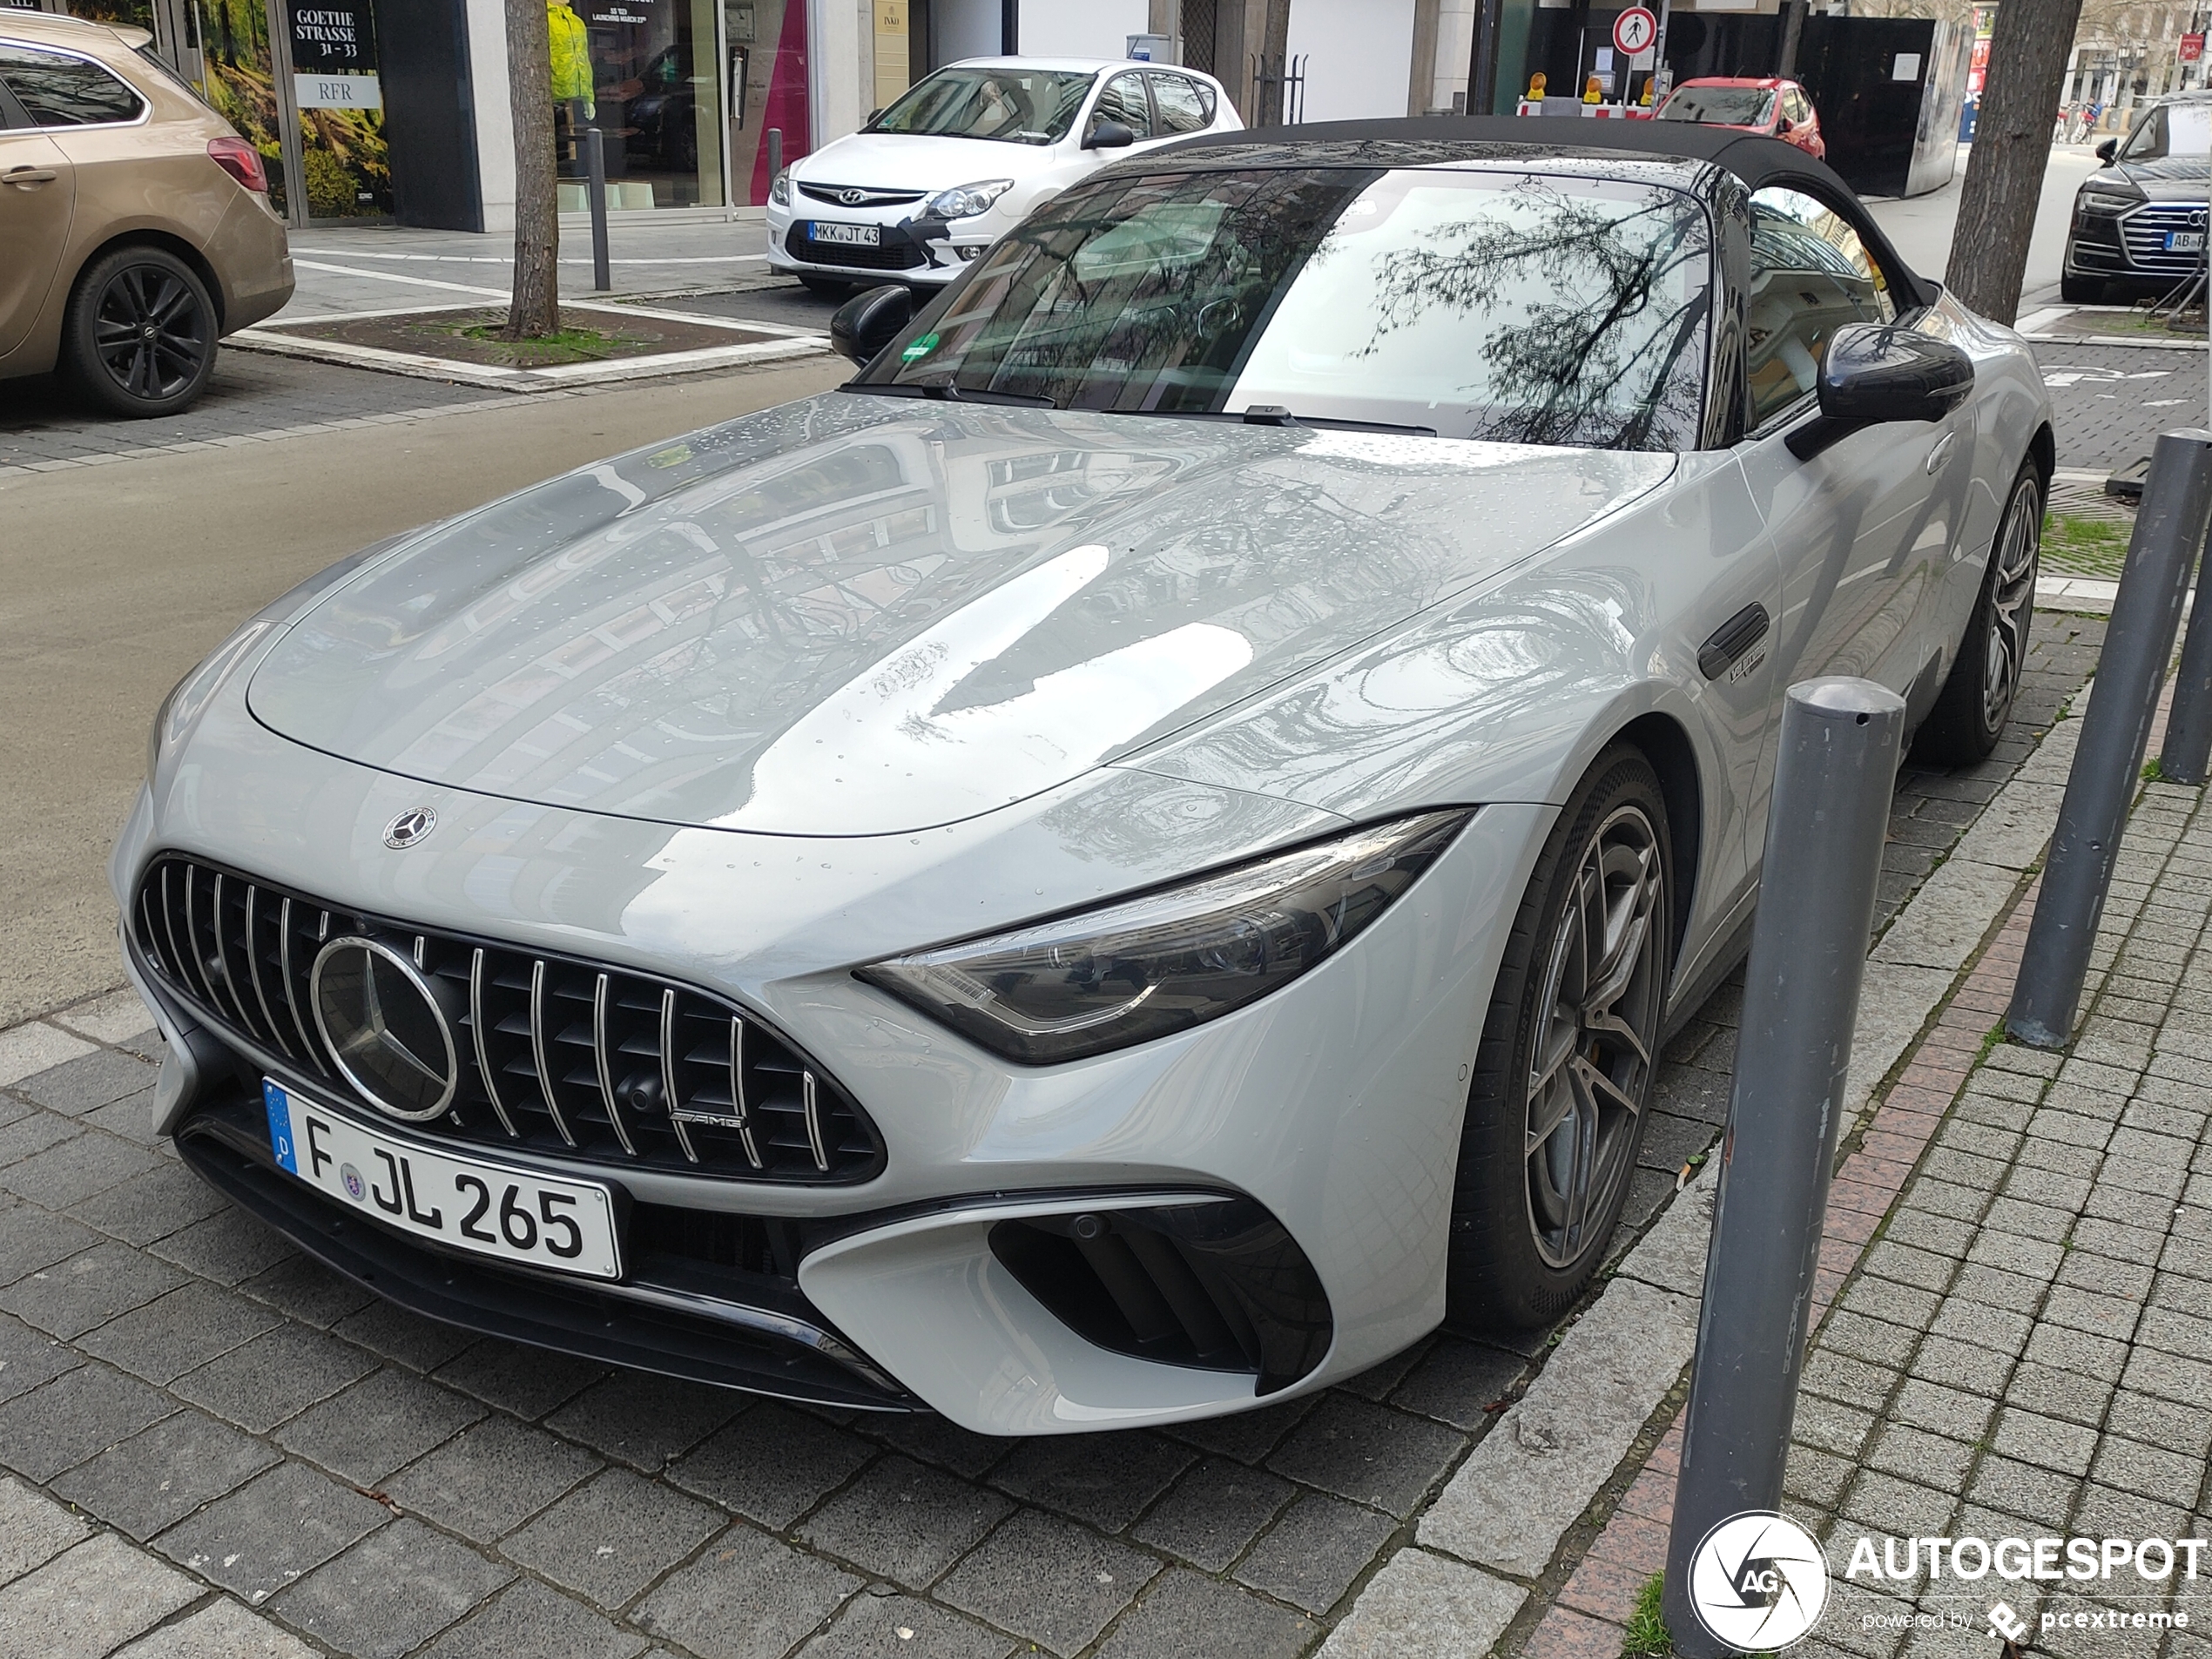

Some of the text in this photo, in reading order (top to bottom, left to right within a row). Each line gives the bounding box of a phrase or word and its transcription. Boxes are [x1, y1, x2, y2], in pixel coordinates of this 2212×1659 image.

[296, 9, 354, 26] GOETHE
[296, 25, 356, 42] STRASSE
[319, 43, 333, 57] 31
[344, 44, 358, 57] 33
[318, 82, 354, 101] RFR
[815, 225, 879, 243] MKK JT 43
[2174, 234, 2190, 247] AB
[691, 1114, 742, 1129] AMG
[278, 1136, 289, 1156] D
[307, 1116, 583, 1258] F JL 265
